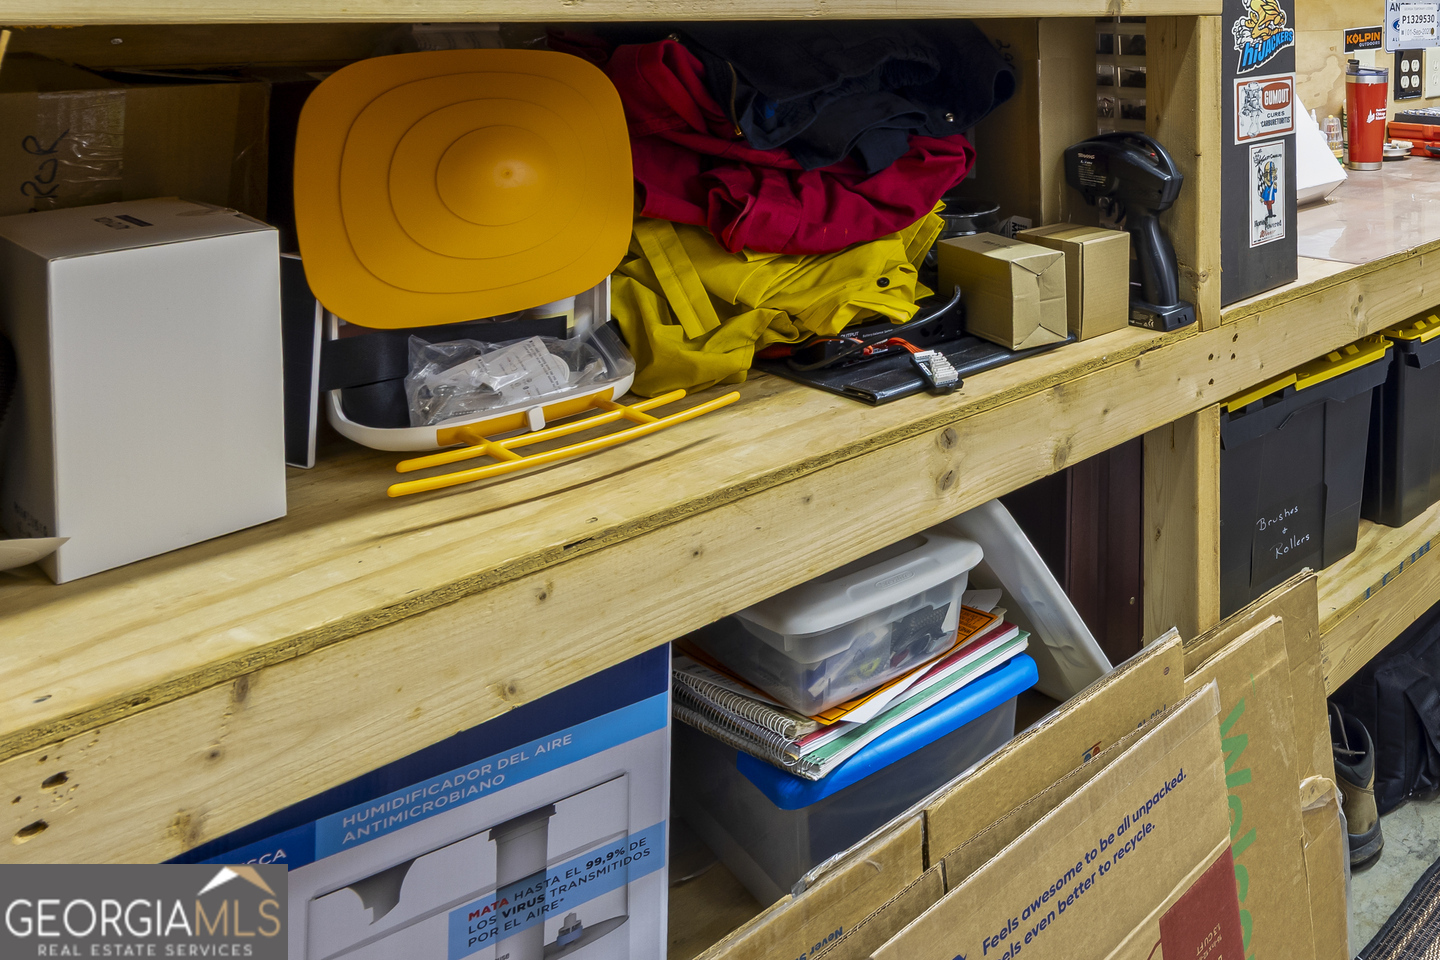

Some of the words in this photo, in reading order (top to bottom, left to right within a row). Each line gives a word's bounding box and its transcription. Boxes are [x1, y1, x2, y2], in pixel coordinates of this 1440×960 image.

[1402, 14, 1435, 24] P1329530
[1346, 32, 1380, 44] KOLPIN
[1359, 40, 1380, 48] OUTDOORS
[1264, 88, 1290, 106] GUMOUT
[1267, 110, 1285, 118] CURES
[1256, 506, 1299, 531] Brushes
[1270, 534, 1310, 560] Rollers
[343, 763, 492, 828] HUMIDIFICADOR
[497, 750, 530, 770] DEL
[534, 734, 573, 758] AIRE
[342, 774, 506, 844] ANTIMICROBIANO
[982, 916, 1020, 956] Feels
[1022, 861, 1083, 921] awesome
[1084, 849, 1098, 865] to
[1100, 833, 1116, 854] be
[1117, 814, 1131, 838] all
[1132, 768, 1187, 824] unpacked.
[468, 898, 510, 922] MATA
[514, 876, 560, 902] HASTA
[565, 866, 582, 880] EL
[585, 846, 626, 871] 99,9%
[630, 837, 648, 852] DE
[468, 916, 498, 935] LOS
[502, 894, 546, 919] VIRUS
[550, 847, 651, 898] TRANSMITIDOS
[1024, 910, 1056, 944] even
[1057, 872, 1096, 916] better
[1098, 860, 1112, 877] to
[1112, 820, 1156, 864] recycle.
[468, 927, 500, 948] POR
[504, 918, 522, 932] EL
[810, 925, 844, 956] Never
[1204, 932, 1213, 946] CU
[1196, 942, 1204, 957] FT
